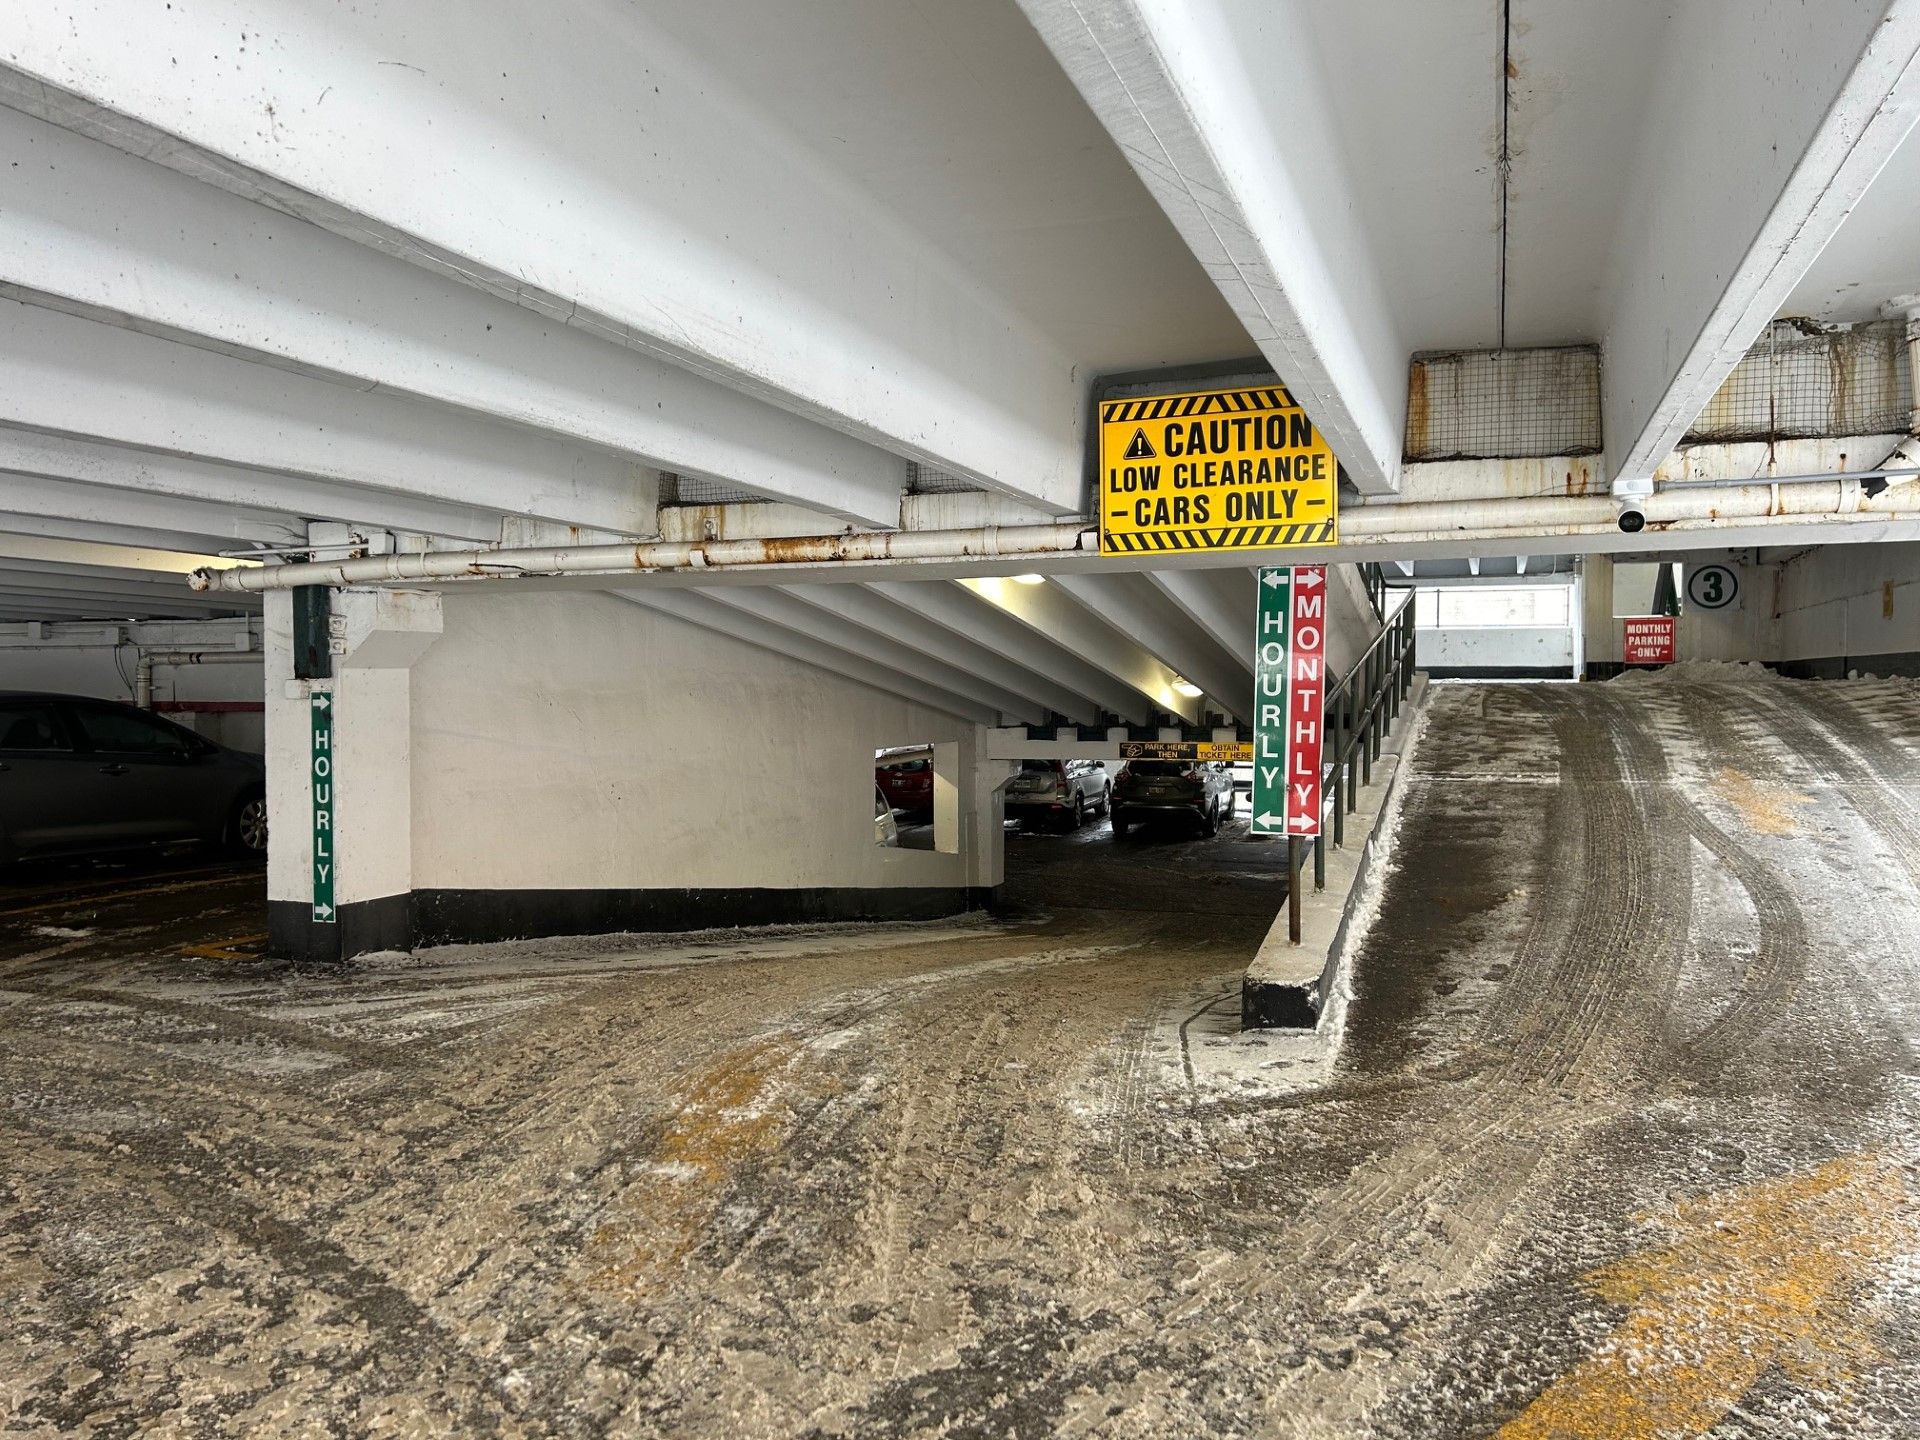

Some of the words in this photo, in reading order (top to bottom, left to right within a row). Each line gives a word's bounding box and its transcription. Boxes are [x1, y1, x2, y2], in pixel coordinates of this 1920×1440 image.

[1164, 413, 1312, 458] CAUTION
[1110, 465, 1161, 493] LOW
[1173, 453, 1326, 489] CLEARANCE
[1703, 571, 1723, 602] 3
[1627, 623, 1671, 634] MONTHLY
[1628, 635, 1670, 645] PARKING
[1260, 611, 1284, 789] HOURLY
[1295, 595, 1321, 806] MONTHLY
[315, 730, 330, 884] HOURLY
